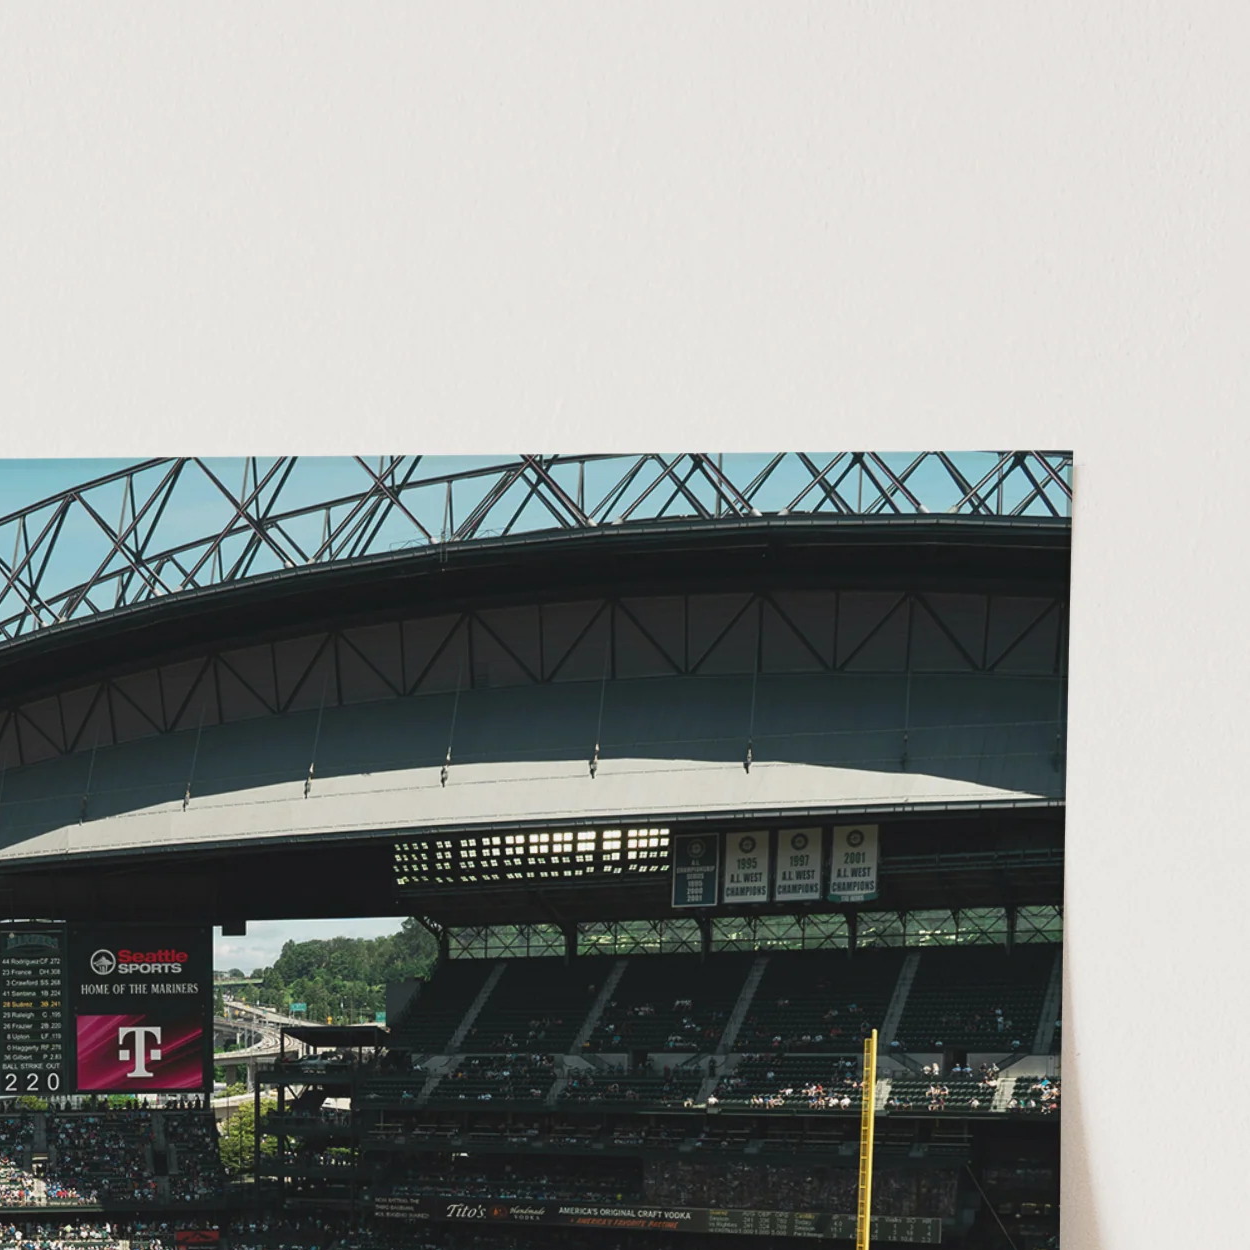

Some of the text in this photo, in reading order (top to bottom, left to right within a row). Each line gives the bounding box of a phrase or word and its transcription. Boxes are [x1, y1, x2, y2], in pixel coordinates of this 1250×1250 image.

[790, 855, 810, 867] 1997
[844, 852, 865, 864] 2001
[744, 872, 763, 883] WEST
[796, 870, 815, 880] WEST
[851, 867, 872, 878] WEST
[726, 885, 767, 897] CHAMPIONS
[777, 883, 819, 895] CHAMPIONS
[832, 880, 875, 893] CHAMPIONS
[118, 949, 189, 963] Seattle
[118, 965, 183, 975] SPORTS
[81, 982, 199, 995] HOME OF THE MARINERS
[119, 1026, 162, 1078] T
[20, 1062, 43, 1070] STRIKE
[46, 1062, 61, 1070] OUT
[5, 1072, 60, 1092] 2 2 0
[446, 1203, 486, 1219] Tito's
[558, 1206, 598, 1216] AMERICA'S
[599, 1208, 636, 1218] ORIGINAL
[637, 1210, 662, 1219] CRAFT
[664, 1211, 692, 1220] VODKA
